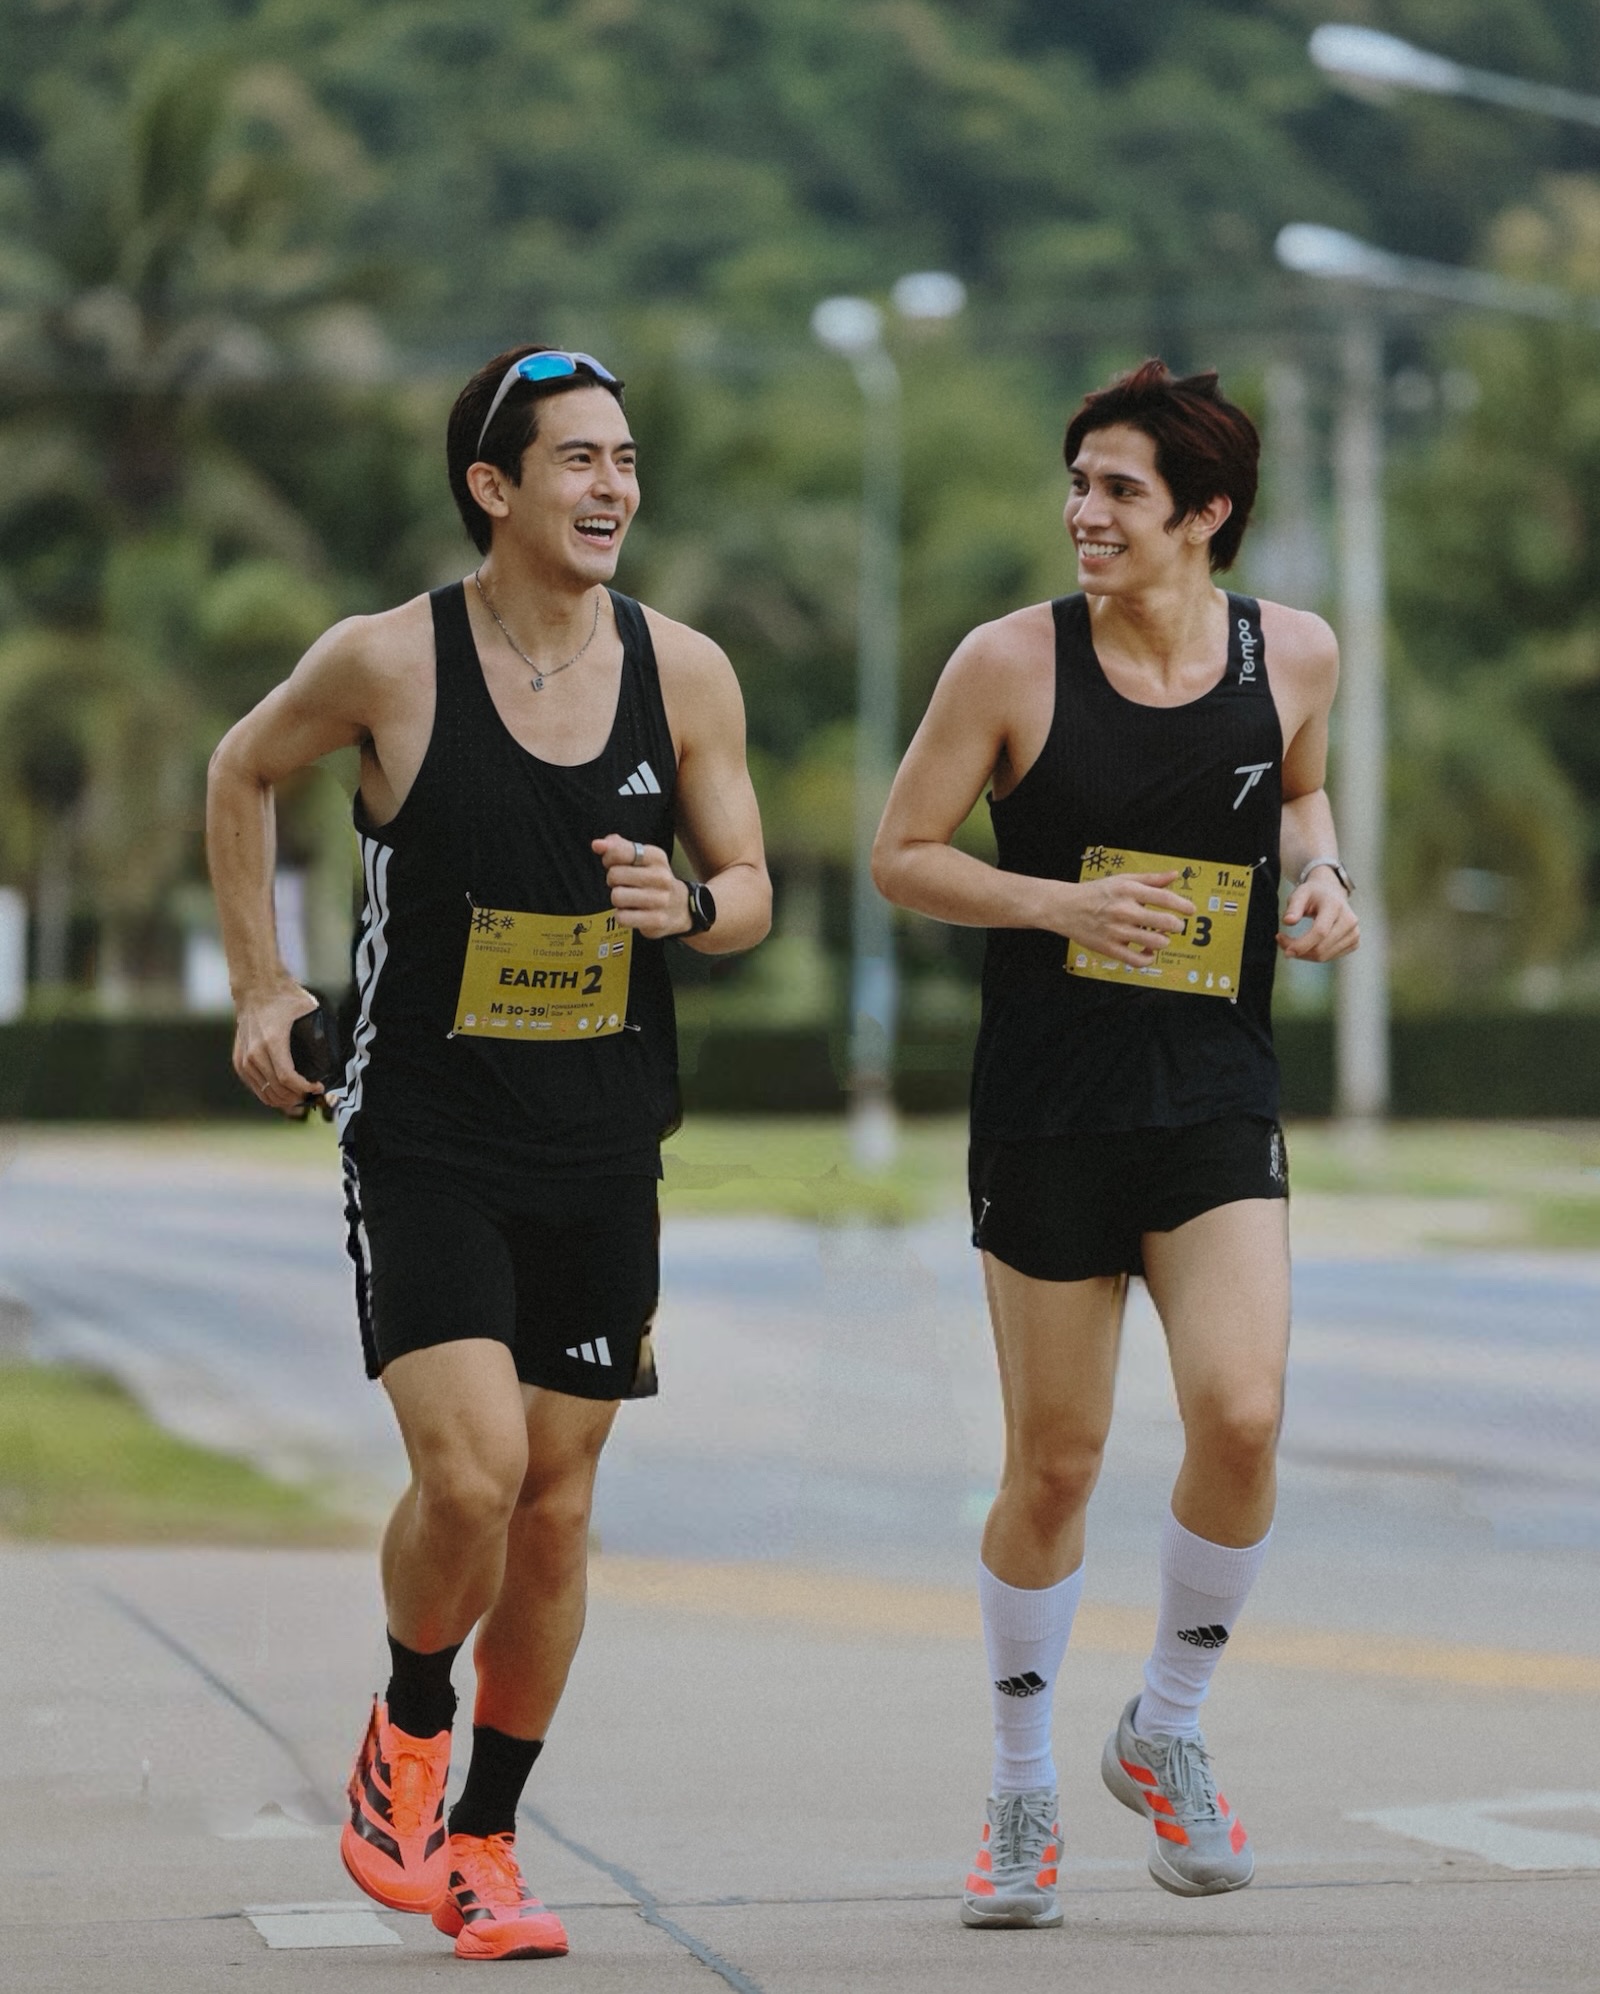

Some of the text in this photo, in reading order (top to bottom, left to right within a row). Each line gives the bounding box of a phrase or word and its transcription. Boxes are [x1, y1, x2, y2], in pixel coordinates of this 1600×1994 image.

[1237, 618, 1258, 685] Tempo
[1217, 871, 1230, 887] 11
[539, 949, 566, 957] October
[499, 965, 603, 995] EARTH 2
[490, 1002, 546, 1017] M 30-39
